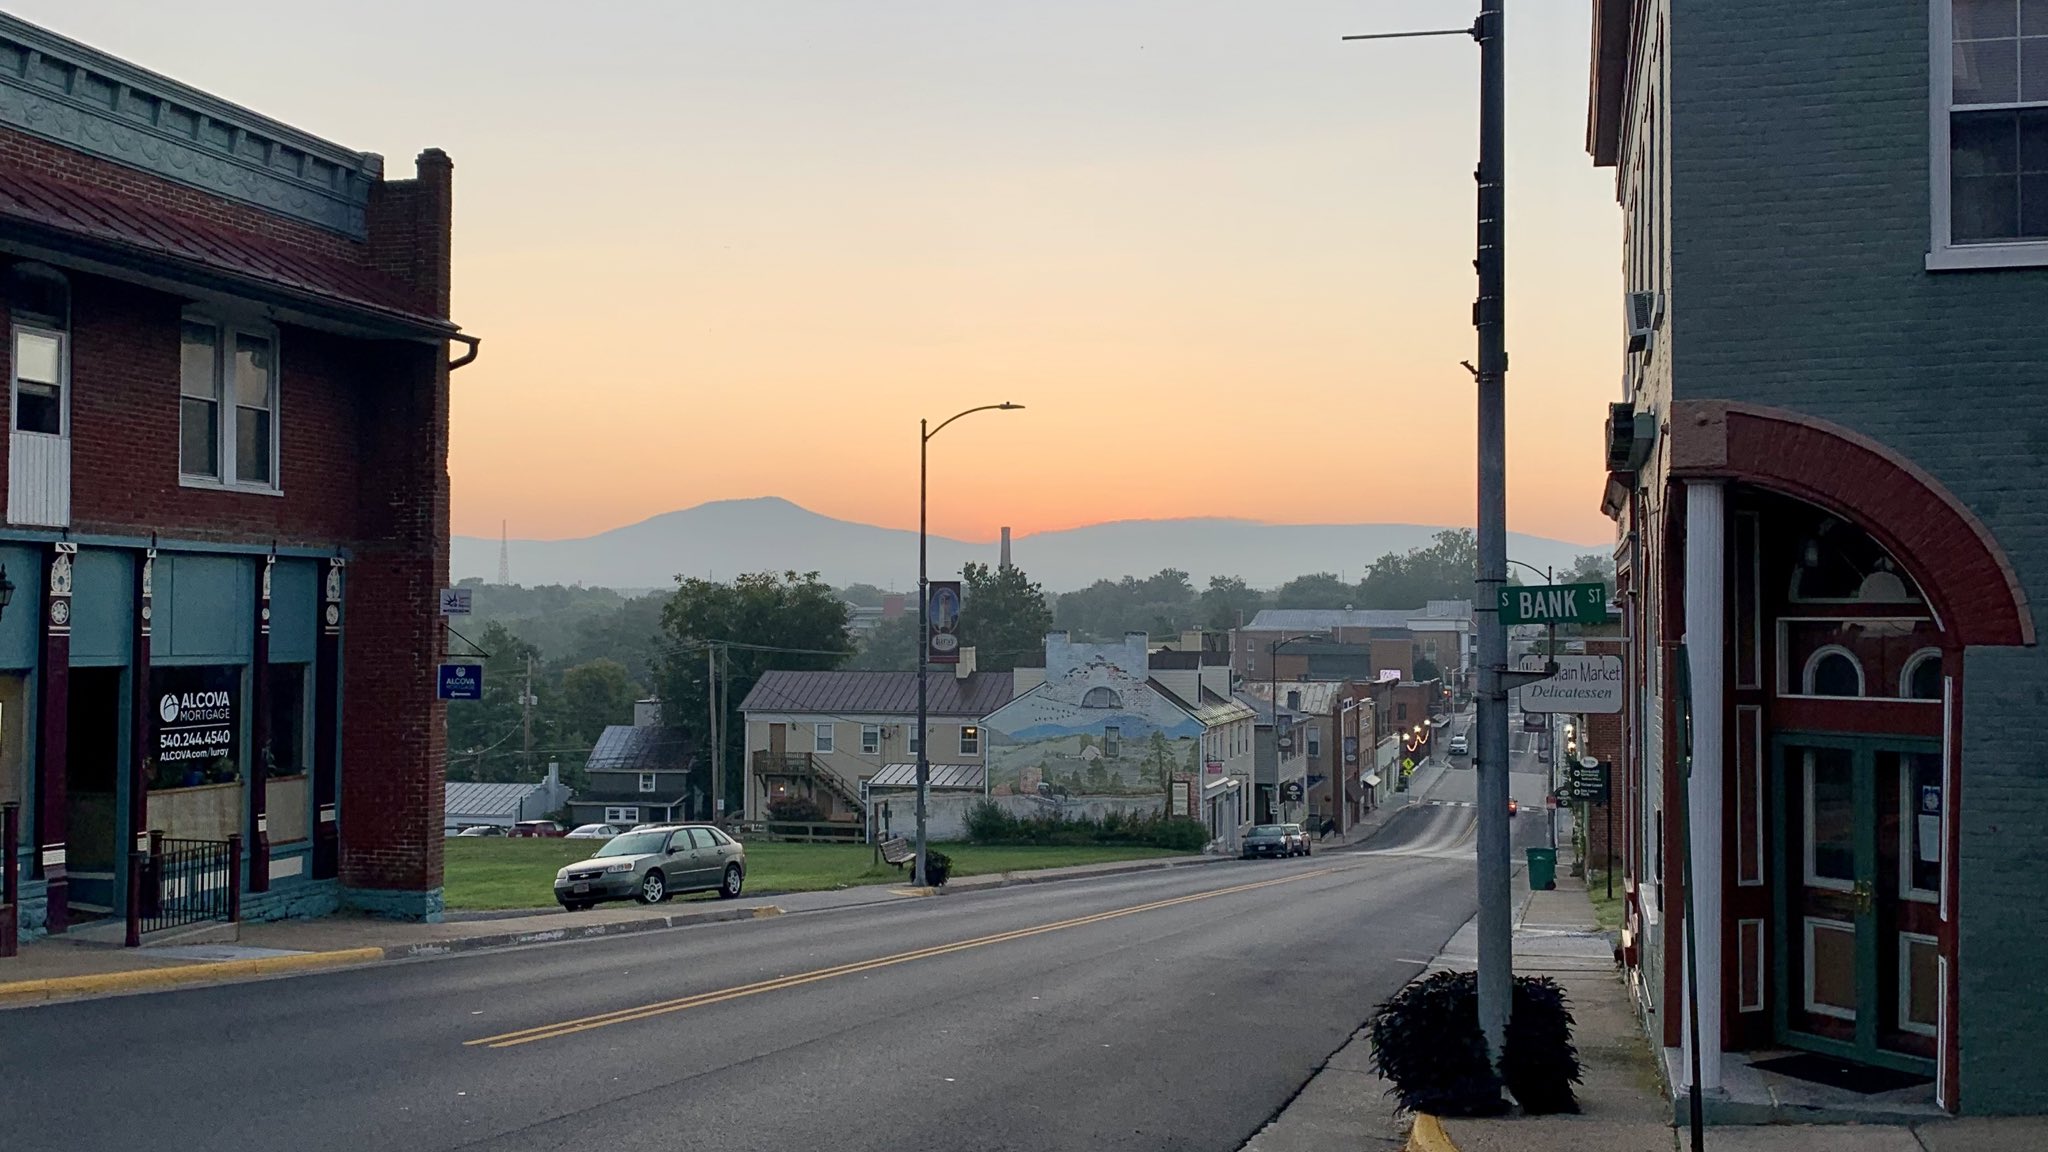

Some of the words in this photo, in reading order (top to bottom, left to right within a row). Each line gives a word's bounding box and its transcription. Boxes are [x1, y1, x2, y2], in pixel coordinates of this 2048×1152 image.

[1502, 592, 1509, 606] S
[1520, 590, 1578, 619] BANK
[1588, 588, 1601, 604] ST
[1580, 660, 1621, 682] Market
[181, 691, 230, 709] ALCOVA
[1531, 685, 1612, 699] Delicatessen
[180, 708, 230, 721] MORTGAGE
[160, 729, 230, 749] 540.244.4540
